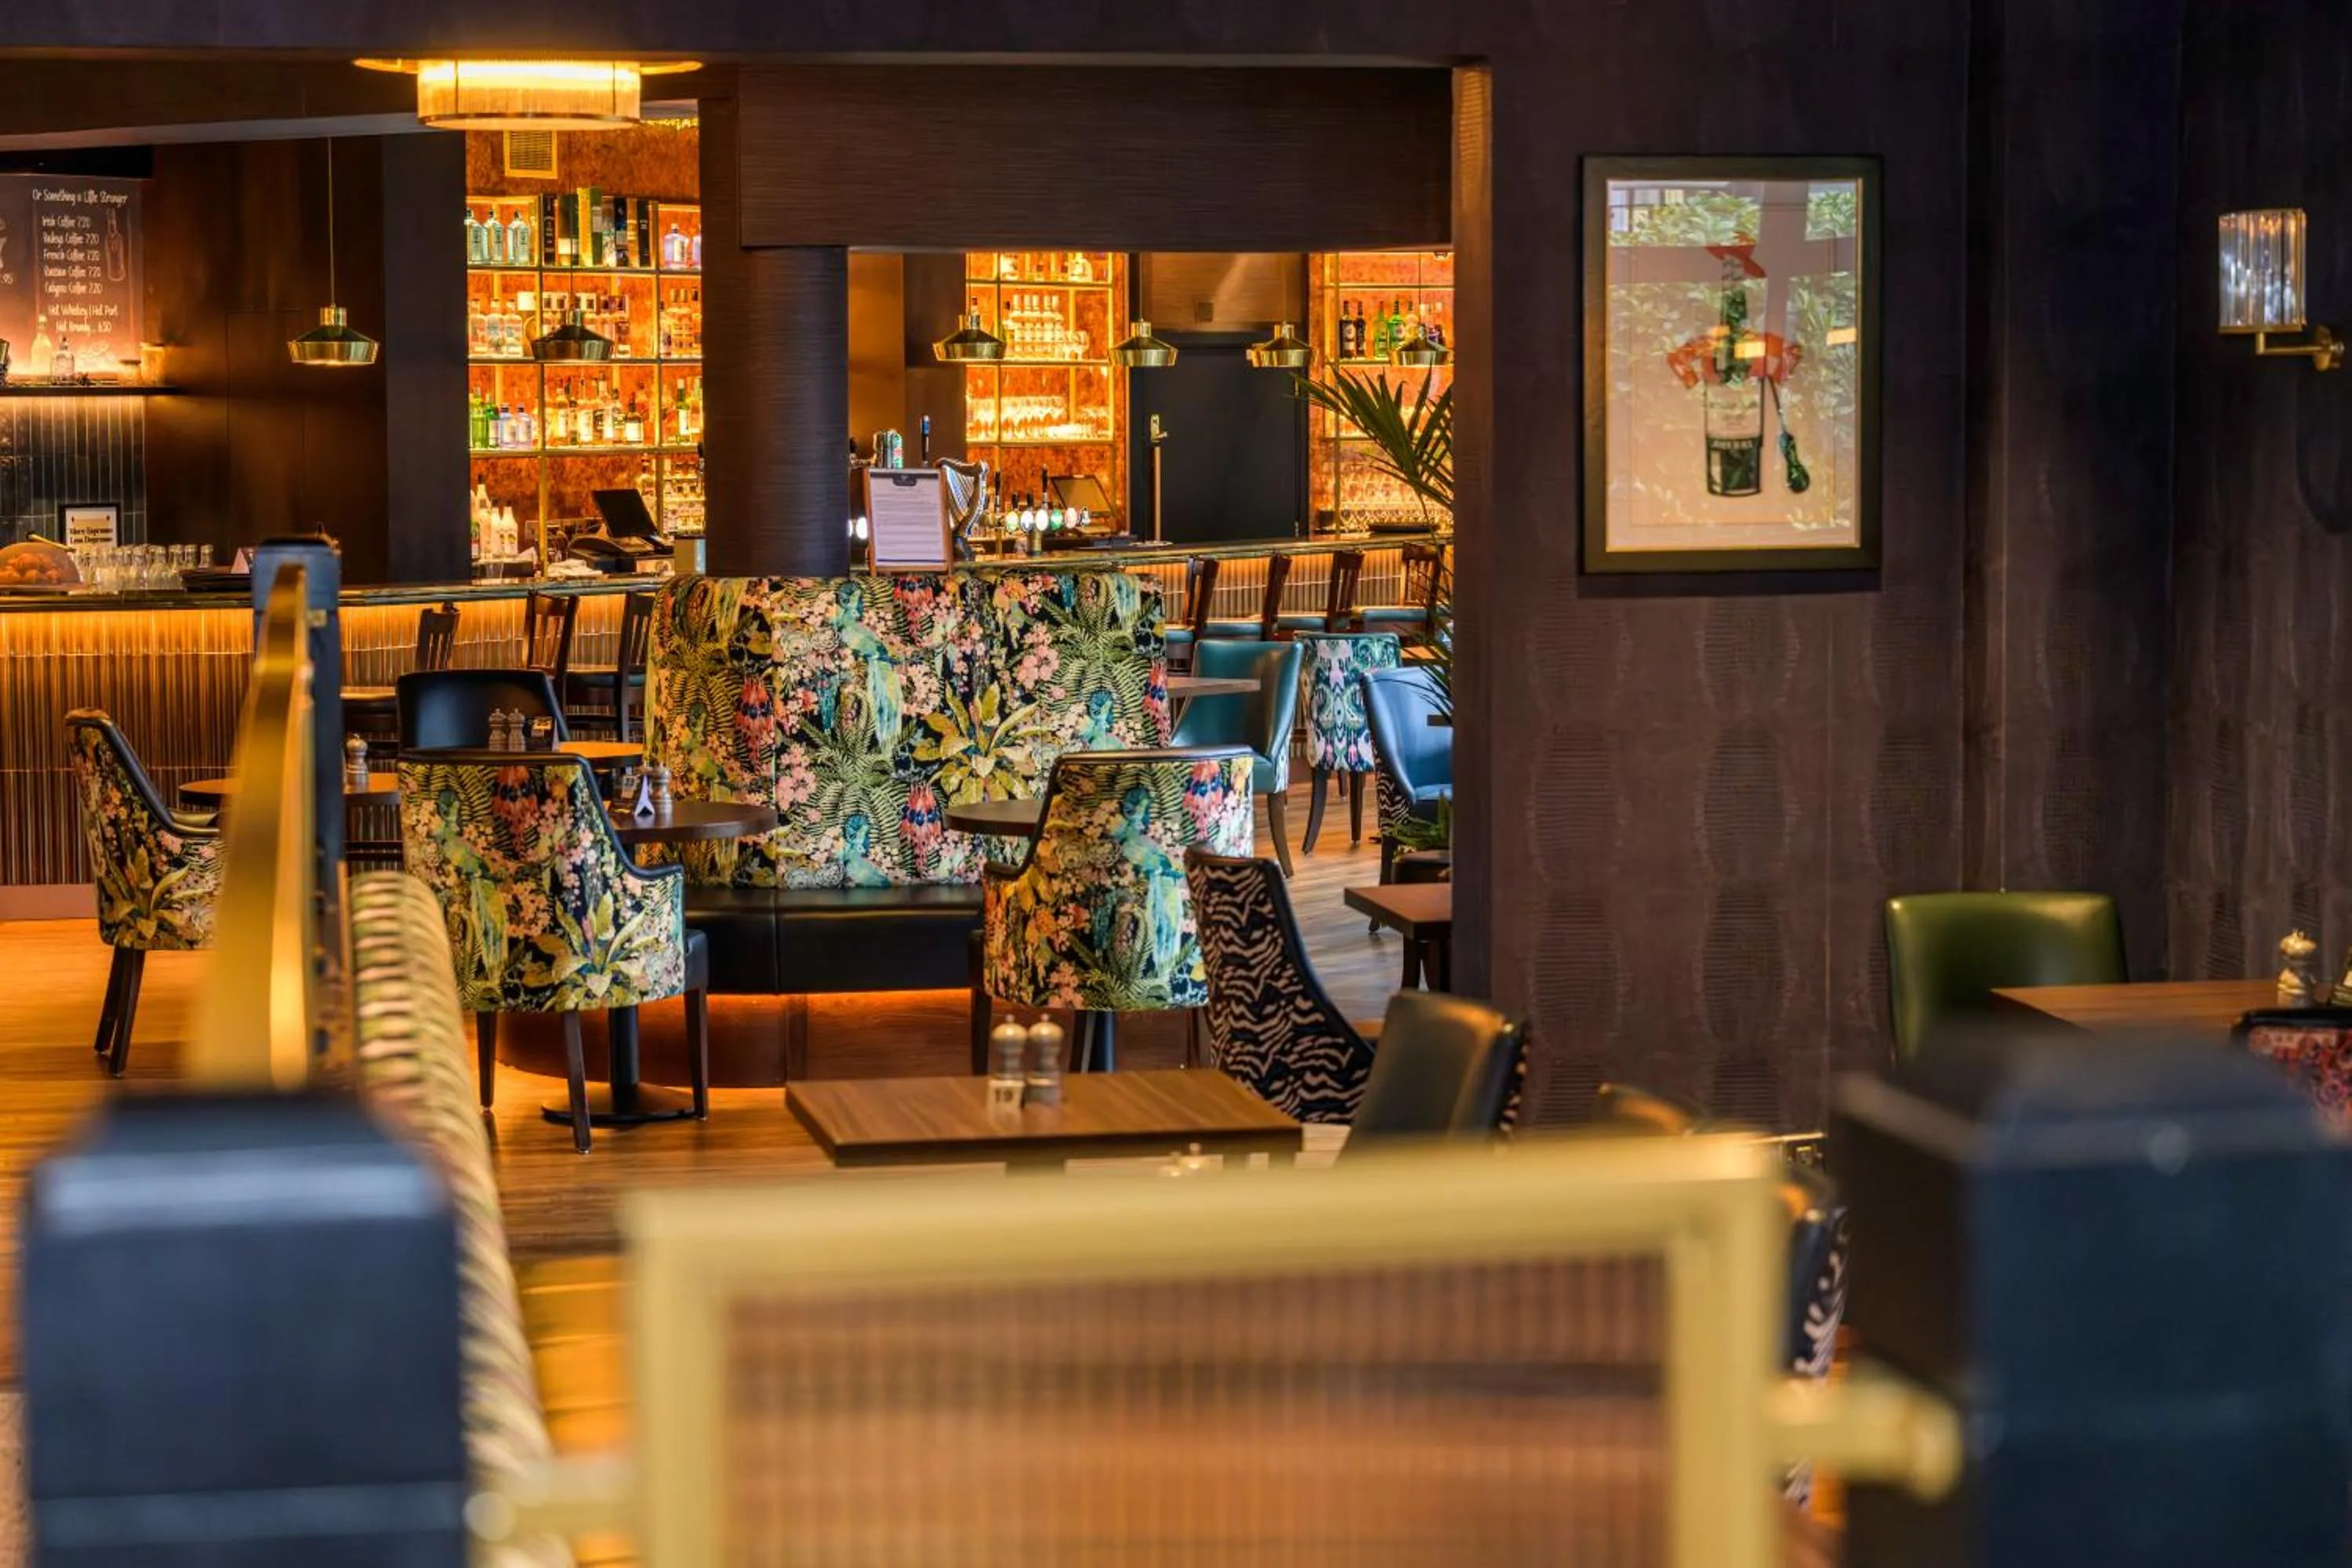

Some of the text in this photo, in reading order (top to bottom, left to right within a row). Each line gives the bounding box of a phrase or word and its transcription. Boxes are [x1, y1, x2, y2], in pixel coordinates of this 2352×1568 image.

[32, 187, 42, 201] Or
[43, 188, 76, 206] Something
[83, 189, 99, 205] Little
[100, 190, 129, 208] Stronger
[57, 216, 76, 228] Coffee
[65, 231, 84, 245] Coffee
[43, 248, 65, 260] French
[66, 248, 85, 262] Coffee
[67, 264, 86, 278] Coffee
[68, 281, 87, 295] Coffee
[103, 303, 119, 317] Port
